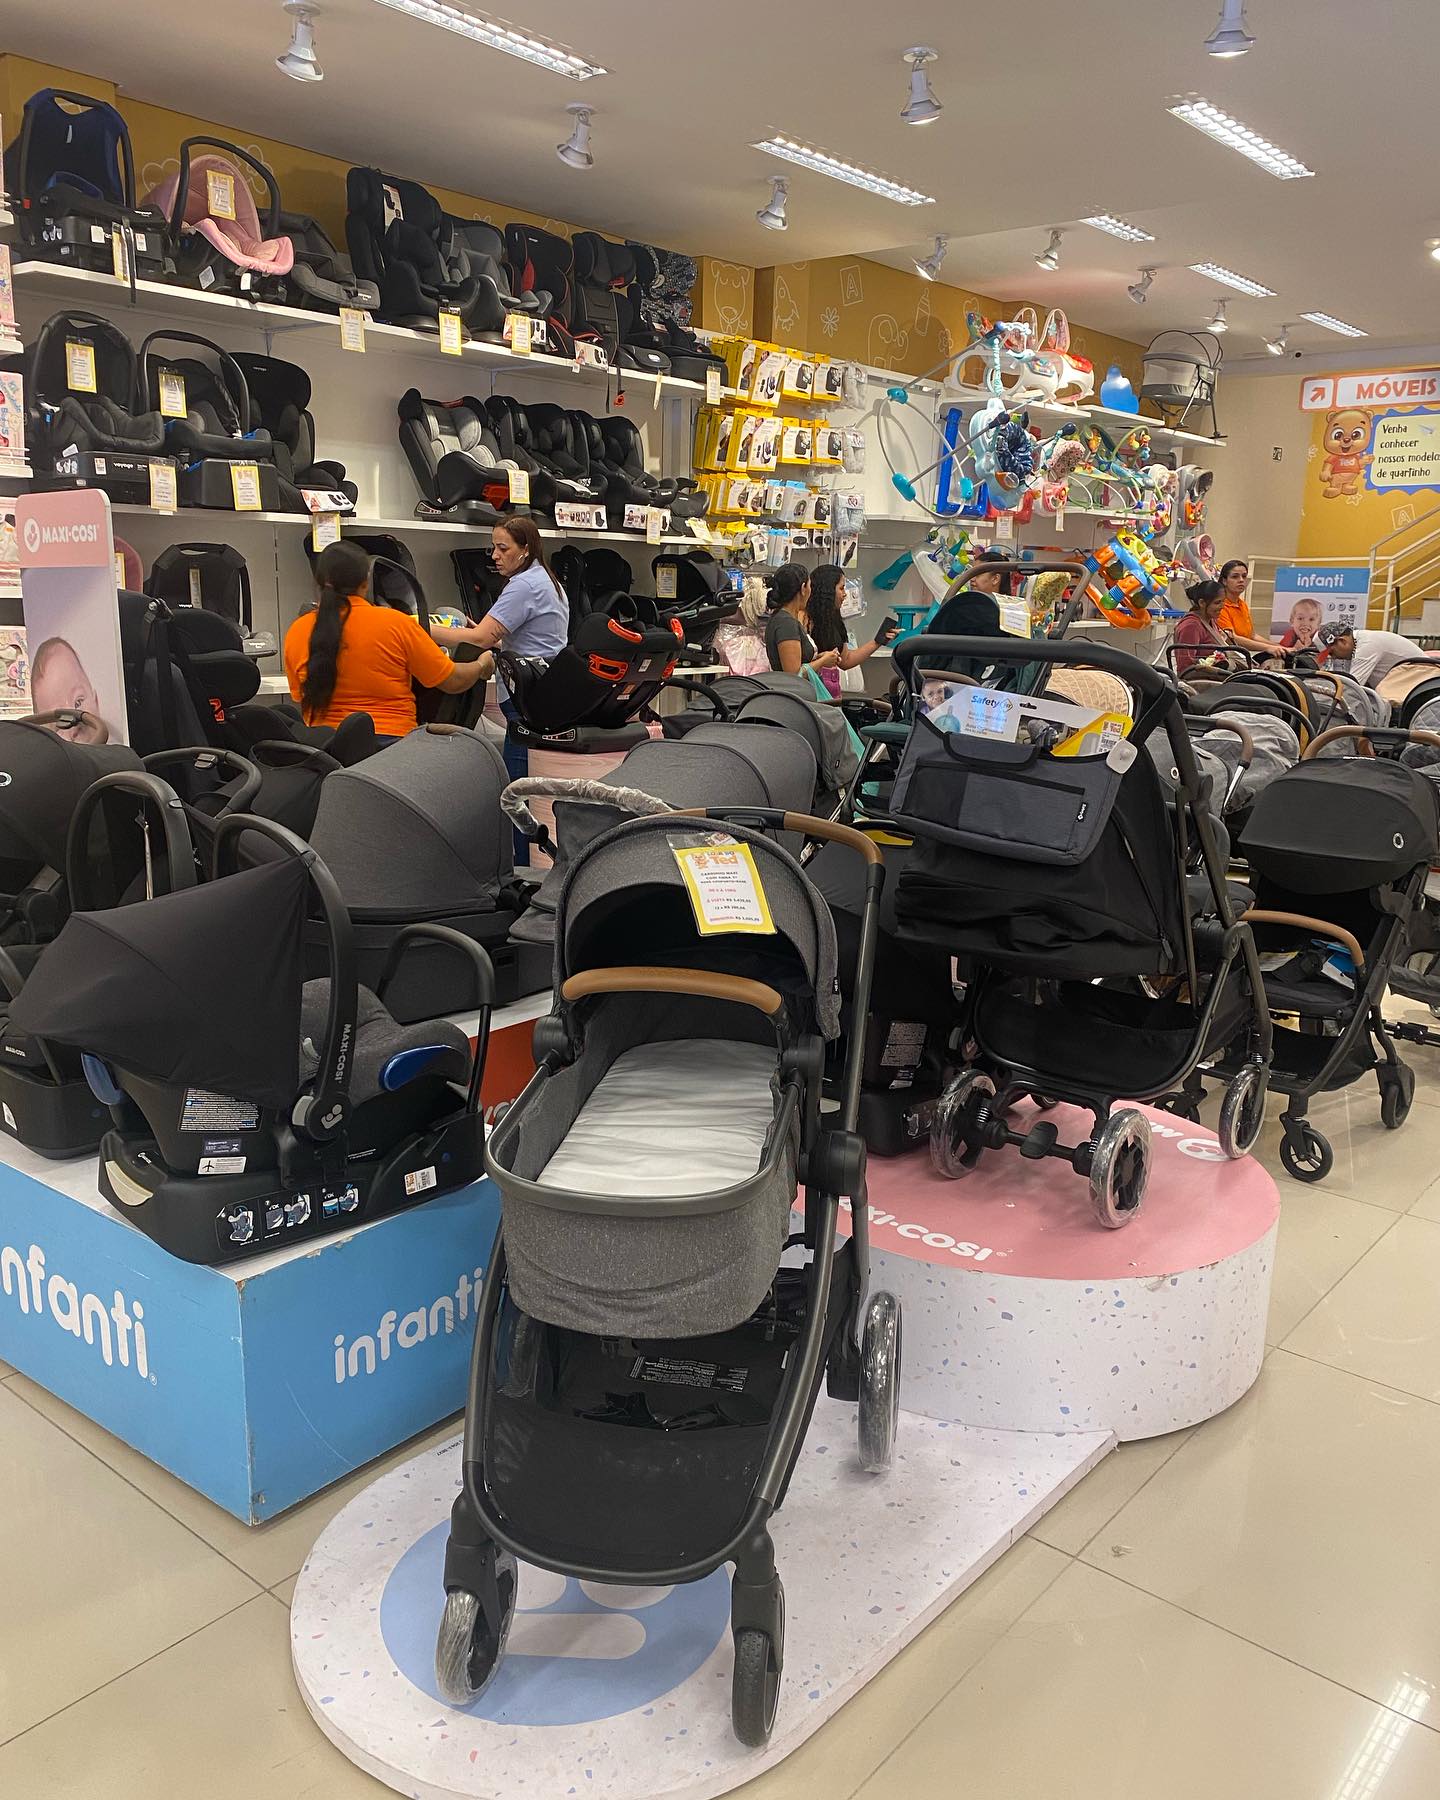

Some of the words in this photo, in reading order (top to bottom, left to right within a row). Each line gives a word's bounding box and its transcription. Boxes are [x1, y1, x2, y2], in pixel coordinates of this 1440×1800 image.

[1356, 377, 1437, 400] MÓVEIS
[1382, 424, 1408, 434] Venha
[1380, 439, 1419, 449] conhecer
[1378, 455, 1405, 464] nossos
[1408, 451, 1440, 462] modelo
[1376, 469, 1387, 478] de
[1390, 467, 1431, 480] quartinho
[1297, 573, 1344, 588] infanti
[970, 695, 1000, 708] Safety
[709, 855, 739, 865] Ted
[1, 1244, 148, 1379] nfanti
[334, 1267, 482, 1384] infanti
